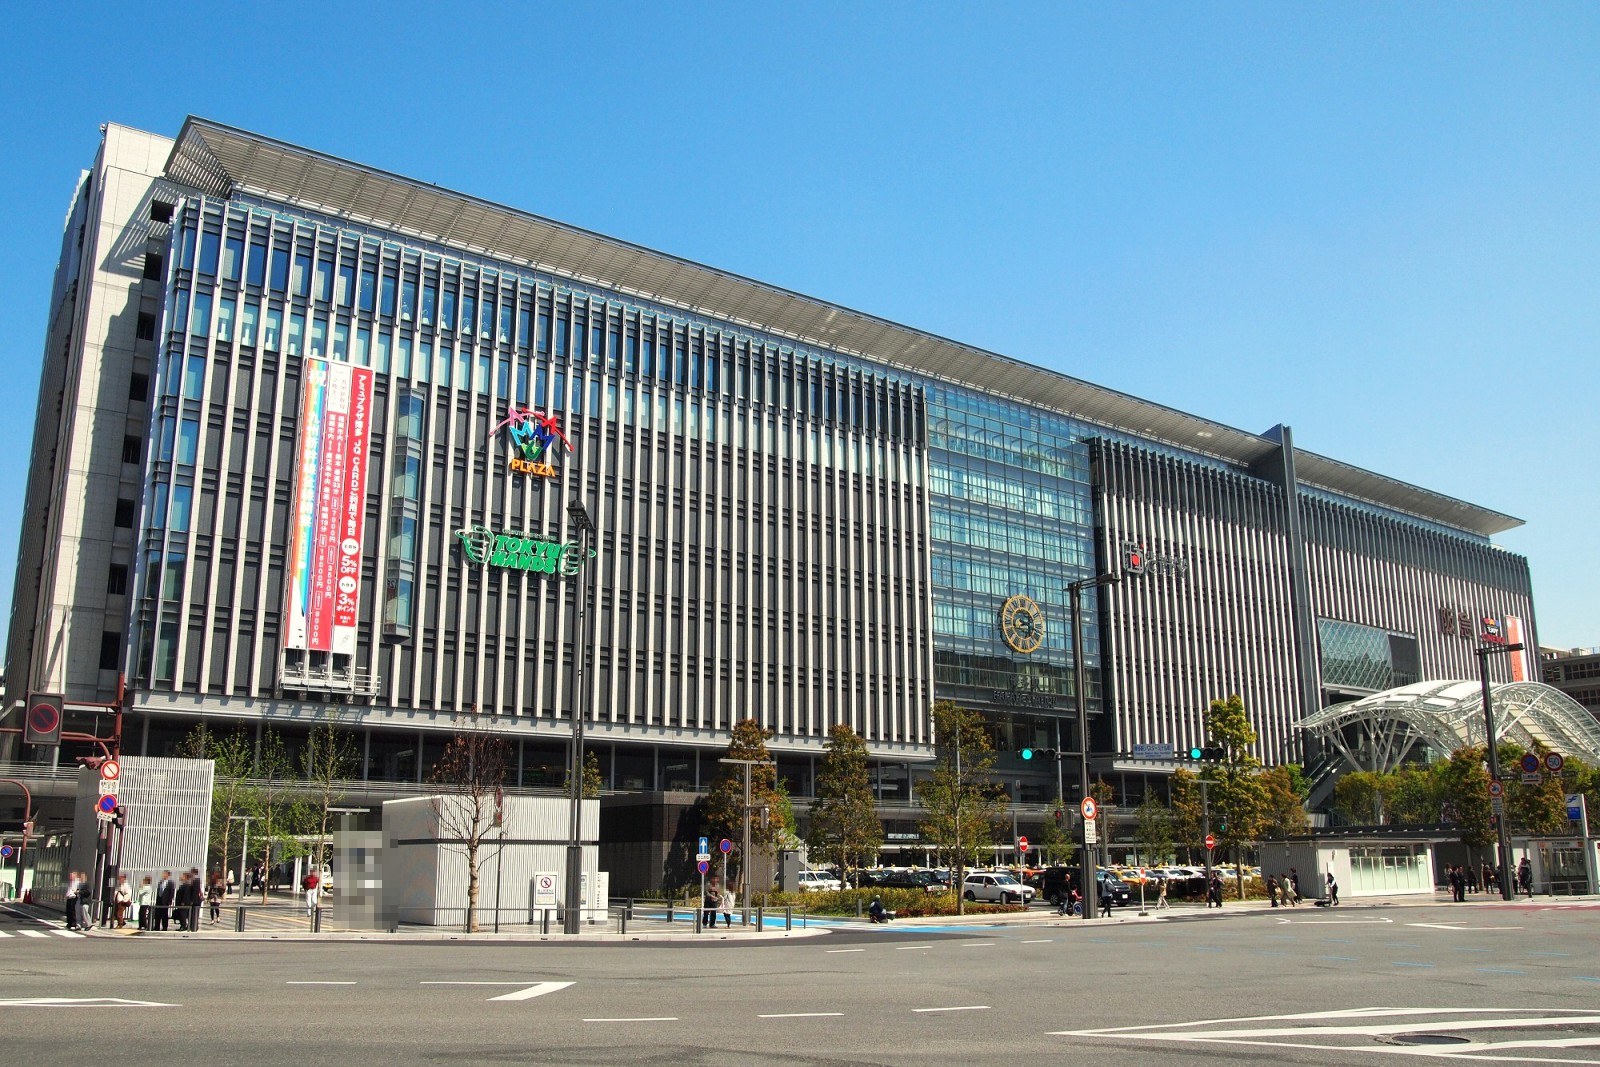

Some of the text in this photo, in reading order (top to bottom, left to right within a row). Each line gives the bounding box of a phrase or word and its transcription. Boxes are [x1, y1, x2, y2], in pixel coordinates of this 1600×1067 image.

[511, 459, 556, 477] PLAZA
[495, 534, 563, 559] TOKYU
[342, 556, 358, 567] 5%
[490, 551, 557, 574] HANDS
[340, 566, 357, 574] OFF
[339, 593, 355, 605] 3%
[1440, 607, 1474, 638] 阪急
[1548, 757, 1560, 767] 50
